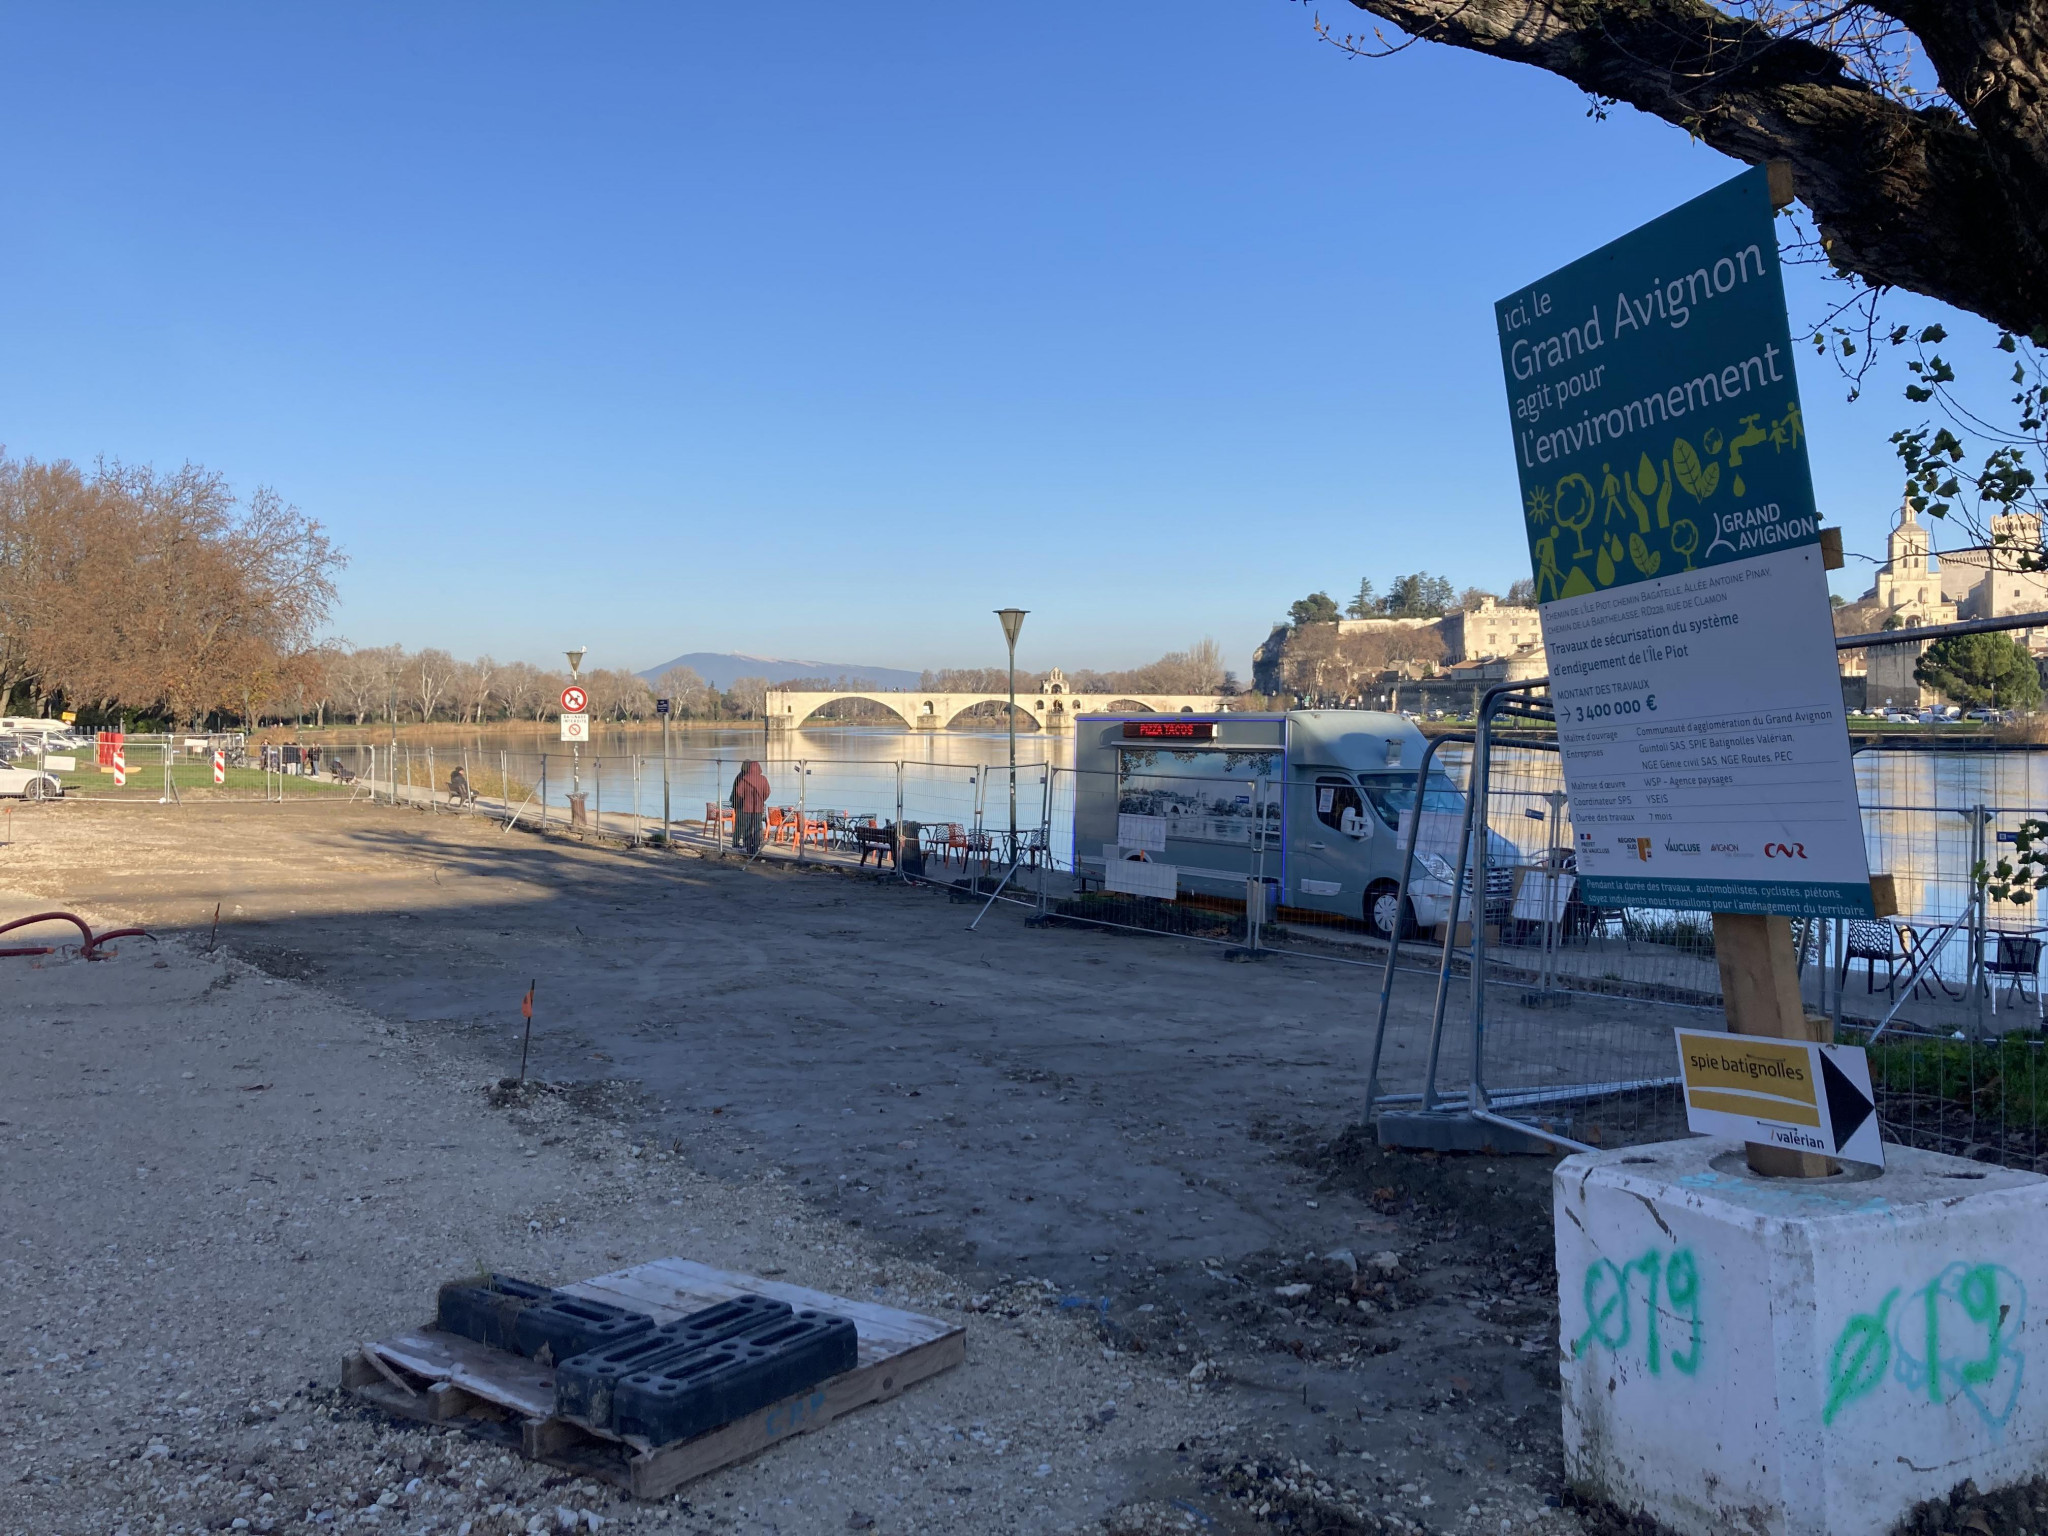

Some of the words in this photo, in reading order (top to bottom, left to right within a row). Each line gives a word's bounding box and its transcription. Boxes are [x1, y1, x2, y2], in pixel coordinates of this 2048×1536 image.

[1505, 299, 1531, 332] ici,
[1533, 291, 1552, 316] le
[1511, 305, 1604, 381] Grand
[1614, 244, 1766, 339] Avignon
[1516, 380, 1552, 423] agit
[1554, 365, 1605, 410] pour
[1521, 343, 1783, 468] l'environnement
[1722, 503, 1781, 533] GRAND
[1738, 516, 1815, 552] AVIGNON
[1546, 608, 1570, 621] CHEMIN
[1571, 607, 1578, 616] DE
[1614, 596, 1640, 608] CHEMIN
[1709, 573, 1744, 588] ANTOINE
[1547, 622, 1572, 635] CHEMIN
[1573, 620, 1581, 630] DE
[1582, 618, 1590, 628] LA
[1666, 602, 1681, 612] RUE
[1682, 599, 1692, 609] DE
[1694, 593, 1727, 606] CLAMON
[1550, 639, 1588, 656] Travaux
[1590, 636, 1603, 649] de
[1604, 624, 1670, 645] sécurisation
[1672, 621, 1687, 634] du
[1690, 613, 1739, 634] système
[1554, 655, 1627, 676] d'endiguement
[1630, 652, 1641, 665] de
[1643, 646, 1663, 662] l'Île
[1666, 645, 1689, 659] Piot
[1558, 686, 1594, 700] MONTANT
[1596, 684, 1611, 695] DES
[1612, 680, 1650, 693] TRAVAUX
[1614, 700, 1641, 715] 000
[1646, 694, 1658, 711] €
[1140, 724, 1162, 735] PIZZA
[1164, 724, 1194, 735] TACOS
[1636, 722, 1685, 736] Communauté
[1687, 718, 1750, 733] d'agglomération
[1752, 716, 1764, 726] du
[1766, 713, 1793, 725] Grand
[1794, 710, 1832, 723] Avignon
[1566, 749, 1604, 759] Entreprises
[1638, 742, 1668, 753] Guintoli
[1689, 739, 1707, 749] SPIE
[1709, 736, 1755, 750] Batignolles
[1642, 760, 1658, 770] NGE
[1660, 759, 1682, 769] Génie
[1683, 757, 1700, 767] civil
[1720, 754, 1739, 764] NGE
[1774, 751, 1793, 761] PEC
[1644, 778, 1661, 787] WSP
[1669, 776, 1696, 788] Agence
[1698, 774, 1733, 786] paysages
[1574, 797, 1616, 806] Coordinateur
[1618, 796, 1632, 805] SPS
[1646, 794, 1668, 804] YSEIS
[1597, 813, 1608, 821] des
[1609, 812, 1635, 821] travaux
[1654, 812, 1672, 820] mois
[1664, 837, 1701, 852] VAUCLUSE
[1711, 843, 1739, 852] AVIGNON
[1764, 842, 1808, 858] CNR
[1586, 880, 1614, 889] Pendant
[1616, 880, 1623, 889] la
[1624, 881, 1645, 890] durée
[1647, 882, 1659, 891] des
[1588, 895, 1608, 904] soyez
[1610, 895, 1646, 907] indulgents
[1648, 897, 1666, 905] nous
[1668, 897, 1711, 908] travaillons
[1713, 901, 1732, 911] pour
[1734, 899, 1800, 915] l'aménagement
[1804, 903, 1815, 913] du
[1690, 1054, 1718, 1072] spie
[1721, 1055, 1804, 1081] batignolles
[1776, 1131, 1825, 1149] valérian
